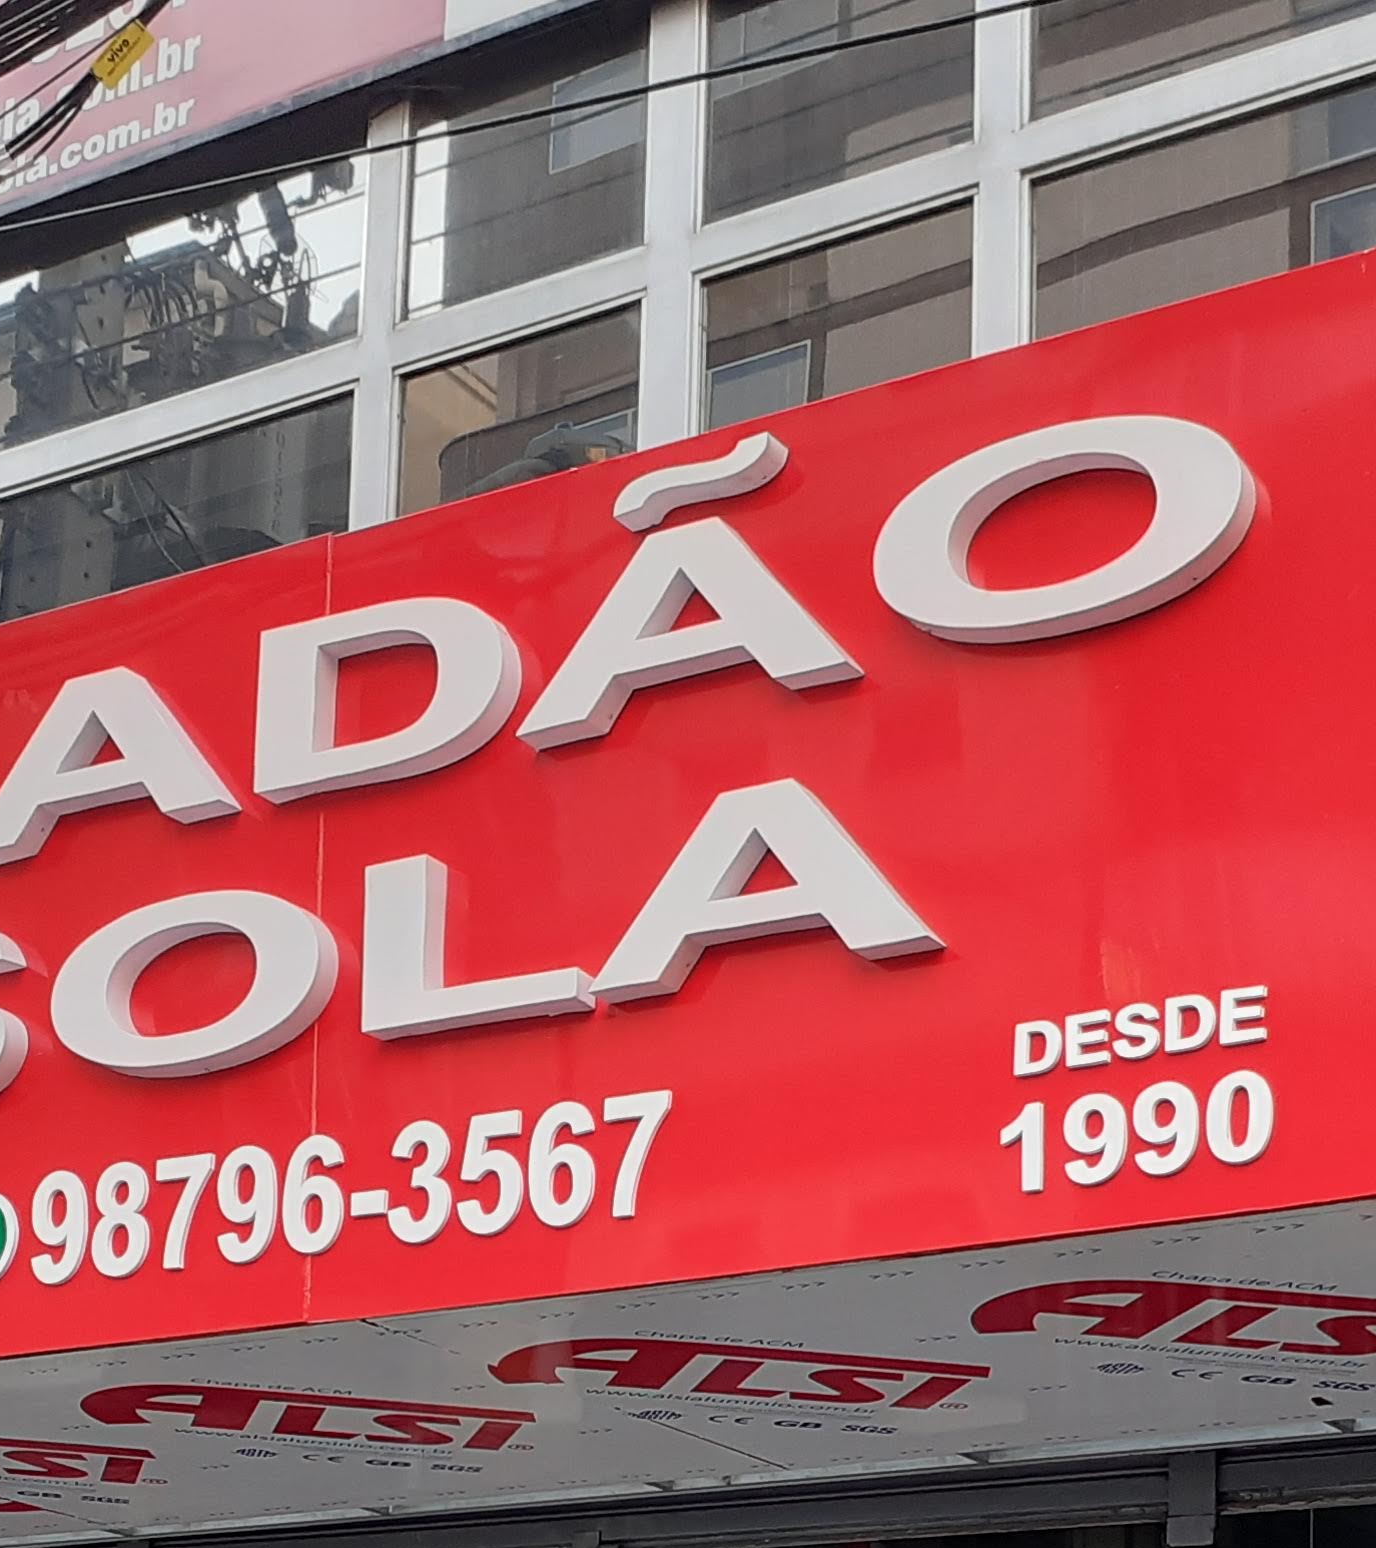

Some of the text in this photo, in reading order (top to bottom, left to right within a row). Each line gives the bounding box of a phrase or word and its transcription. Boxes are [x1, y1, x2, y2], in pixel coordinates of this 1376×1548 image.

[107, 39, 130, 62] vivo
[1012, 984, 1269, 1078] DESDE
[999, 1069, 1276, 1194] 1990
[28, 1090, 673, 1287] 98796-3567
[487, 1337, 991, 1410] ALSI
[80, 1383, 536, 1451] ALSI
